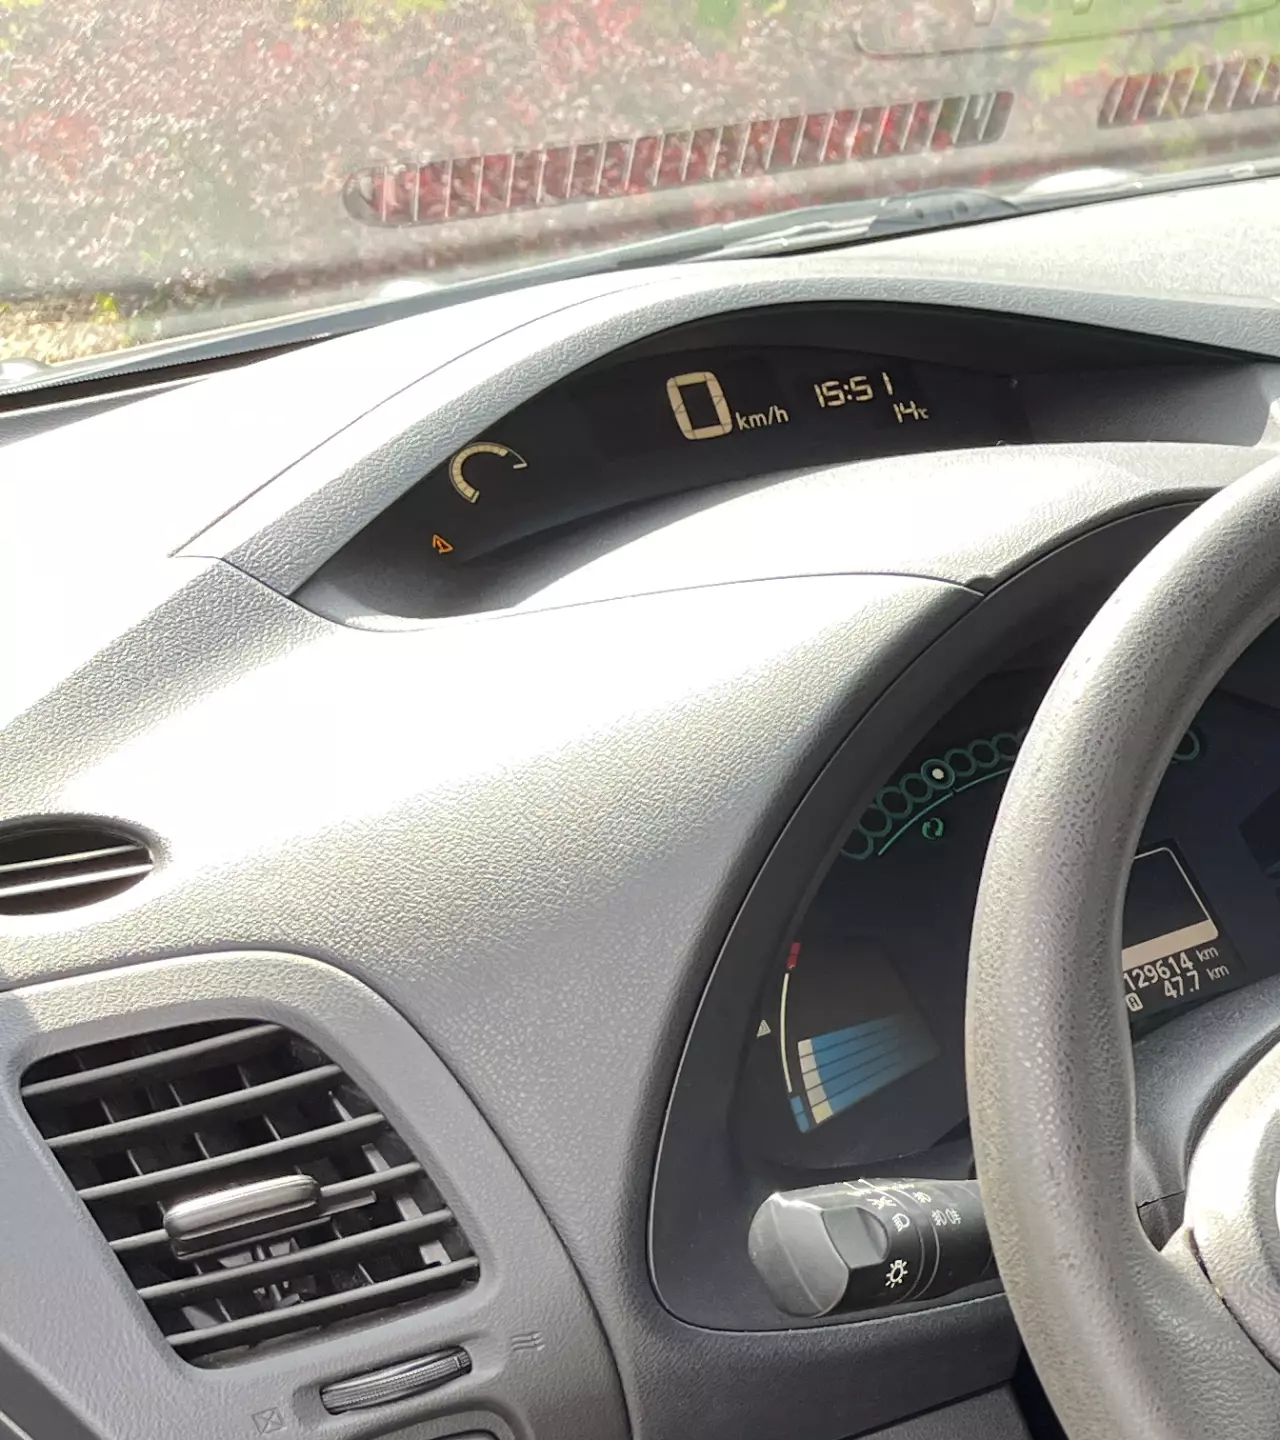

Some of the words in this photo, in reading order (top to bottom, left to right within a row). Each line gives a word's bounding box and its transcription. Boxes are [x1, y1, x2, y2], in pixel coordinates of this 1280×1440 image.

[666, 371, 733, 440] 0
[736, 405, 789, 432] km/h
[814, 372, 894, 408] 15:51
[1123, 951, 1194, 991] 129614
[1196, 946, 1219, 962] km
[1164, 970, 1200, 998] 47.7
[1206, 964, 1229, 981] km
